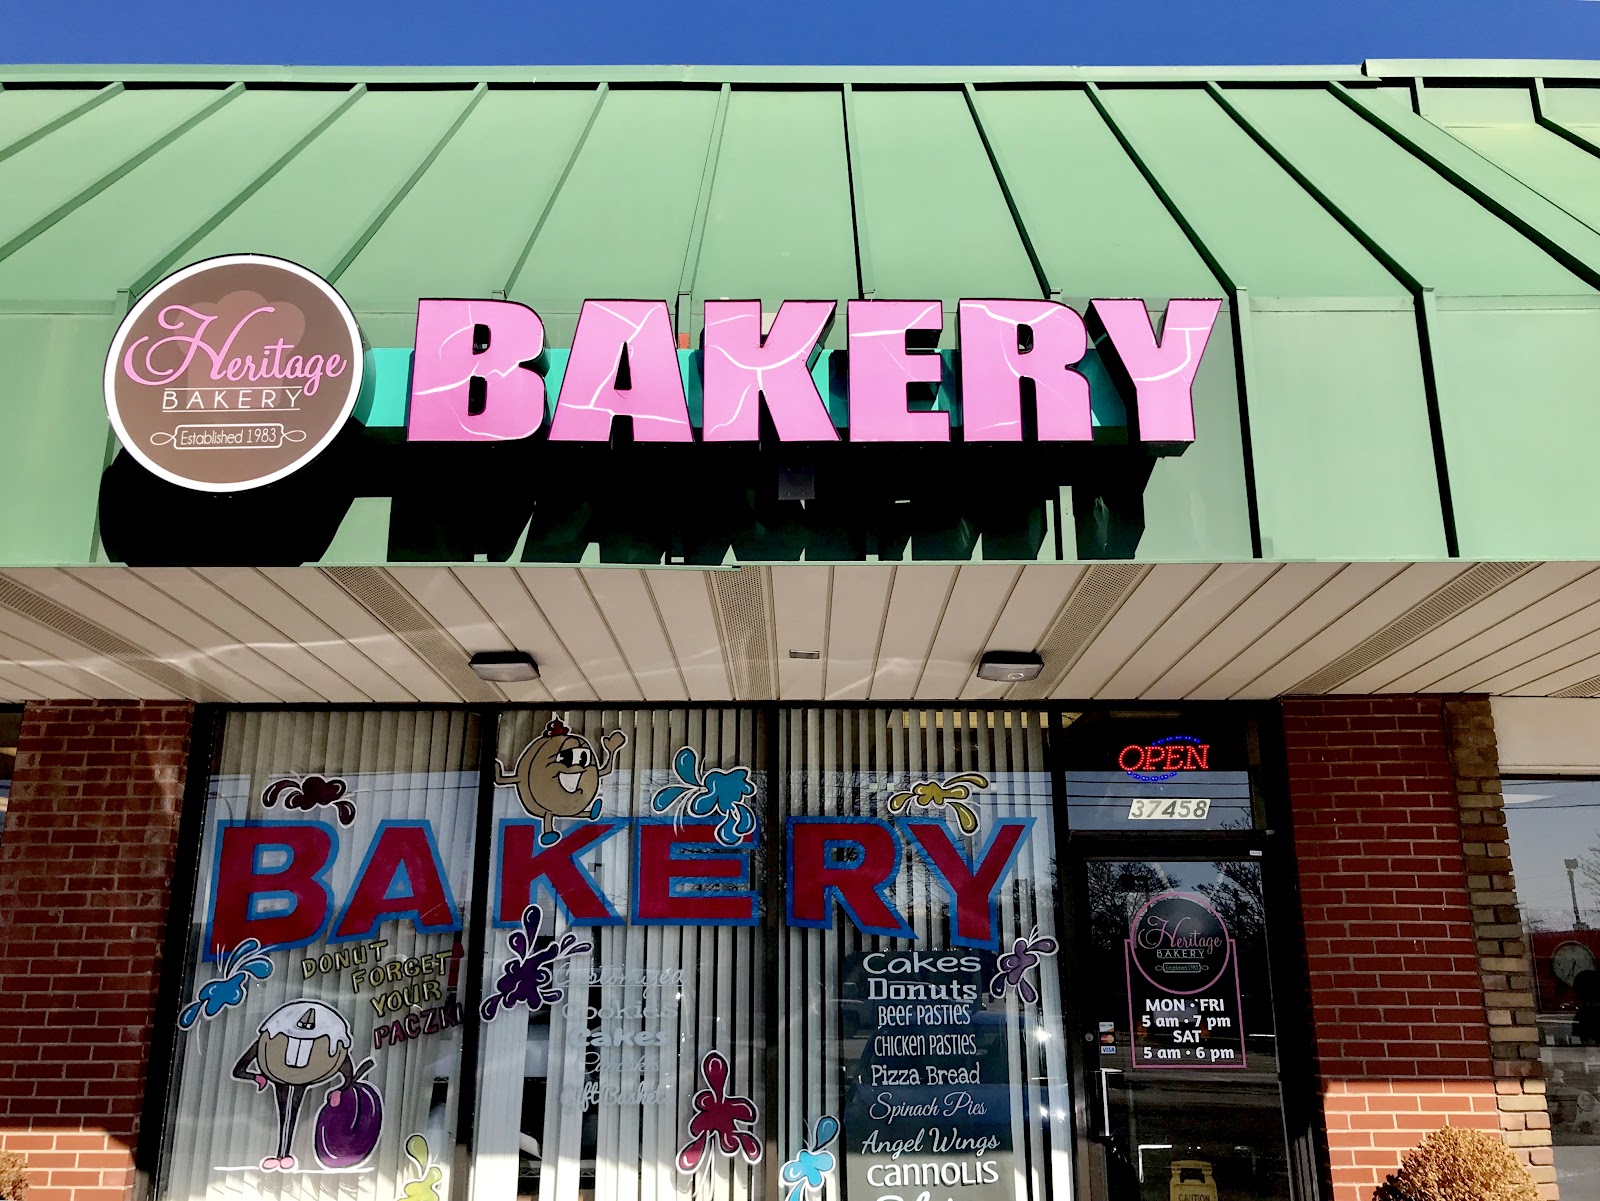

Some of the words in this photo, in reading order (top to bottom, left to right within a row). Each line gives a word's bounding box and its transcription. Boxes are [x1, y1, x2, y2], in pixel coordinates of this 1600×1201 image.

[124, 304, 347, 397] Heritage
[408, 298, 1223, 442] BAKERY
[162, 389, 303, 410] BAKERY
[180, 429, 243, 446] Established
[246, 428, 277, 443] 1983
[1118, 745, 1210, 771] OPEN
[1131, 800, 1208, 818] 37458
[202, 816, 1037, 962] BAKERY
[1138, 916, 1222, 954] Heritage
[301, 940, 388, 979] DONUT
[862, 952, 982, 974] Cakes
[1157, 949, 1205, 958] BAKERY
[351, 950, 453, 993] FORGET
[370, 980, 442, 1017] YOUR
[868, 978, 978, 1001] Donuts
[1145, 999, 1186, 1011] MON
[1200, 999, 1225, 1011] FRI
[374, 1003, 464, 1049] PACZKI
[1142, 1015, 1151, 1027] 5
[1155, 1017, 1180, 1027] am
[1193, 1015, 1202, 1027] 7
[1207, 1017, 1231, 1030] pm
[568, 1027, 669, 1047] Cakes
[1173, 1030, 1202, 1043] SAT
[1143, 1047, 1152, 1059] 5
[1157, 1048, 1181, 1059] am
[1196, 1047, 1205, 1059] 6
[1210, 1048, 1234, 1062] pm
[871, 1064, 921, 1086] Pizza
[926, 1062, 980, 1085] Bread
[869, 1091, 940, 1124] Spinach
[943, 1091, 988, 1117] Pies
[861, 1128, 925, 1160] Angel
[929, 1127, 1000, 1157] Wings
